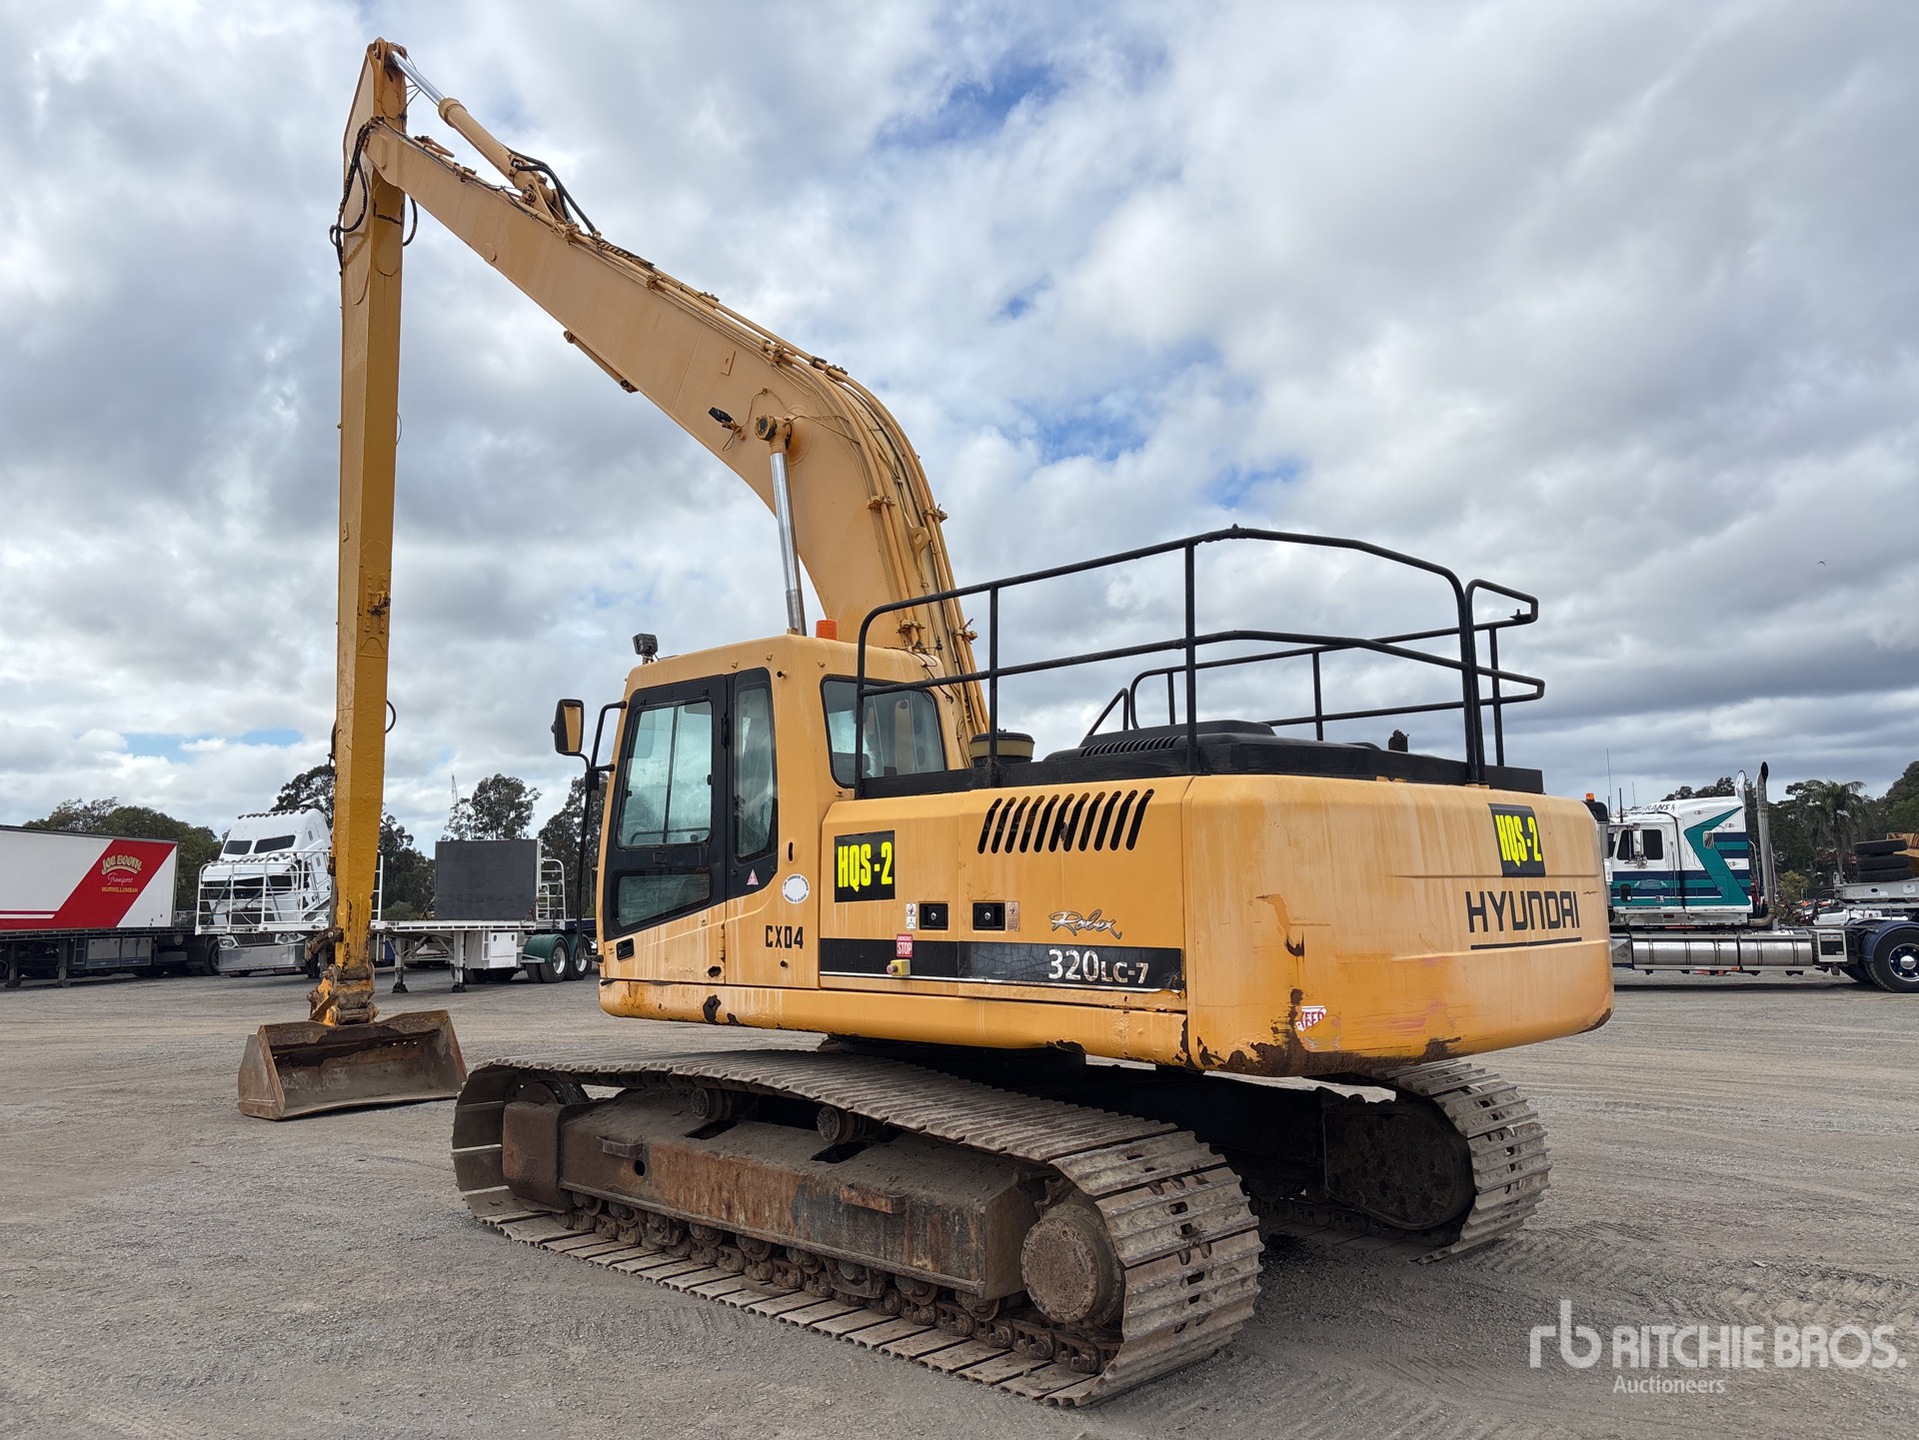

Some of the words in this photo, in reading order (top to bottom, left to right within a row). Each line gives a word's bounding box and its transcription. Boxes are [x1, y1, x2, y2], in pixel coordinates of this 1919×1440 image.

[1495, 815, 1543, 868] HQS-2
[837, 841, 893, 893] HQS-2
[1048, 908, 1123, 940] Robex
[1465, 891, 1580, 933] HYUNDAI
[896, 942, 913, 955] STOP
